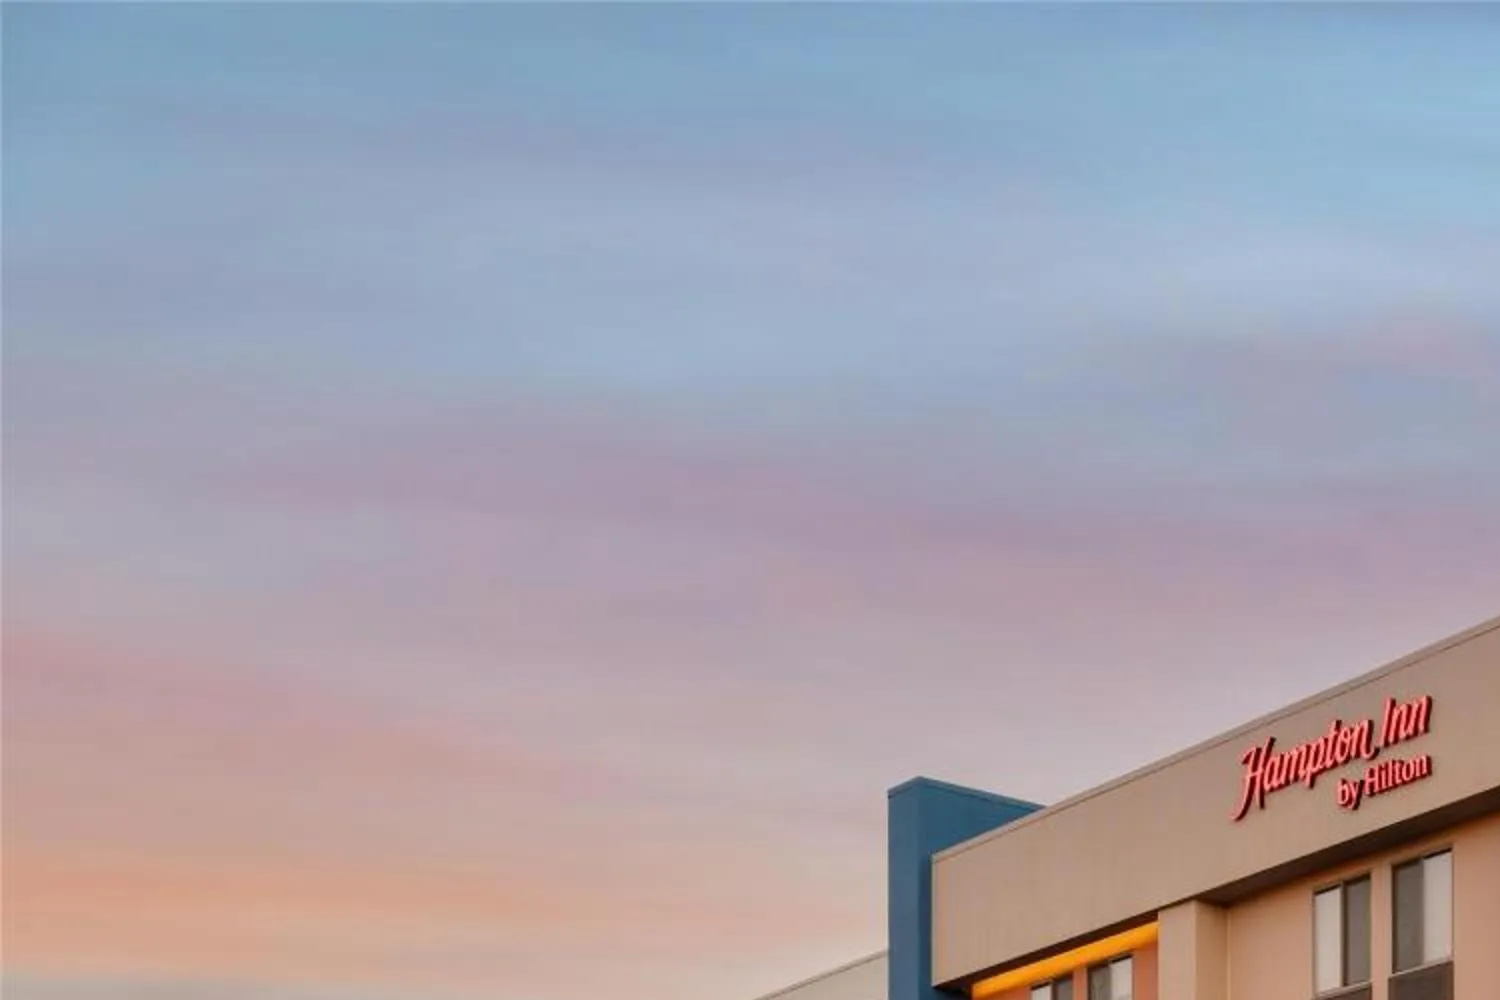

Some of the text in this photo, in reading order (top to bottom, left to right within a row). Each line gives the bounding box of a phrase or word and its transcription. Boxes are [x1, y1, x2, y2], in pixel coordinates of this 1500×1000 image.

[1231, 695, 1432, 821] Hampton Inn
[1336, 755, 1432, 810] by Hilton
